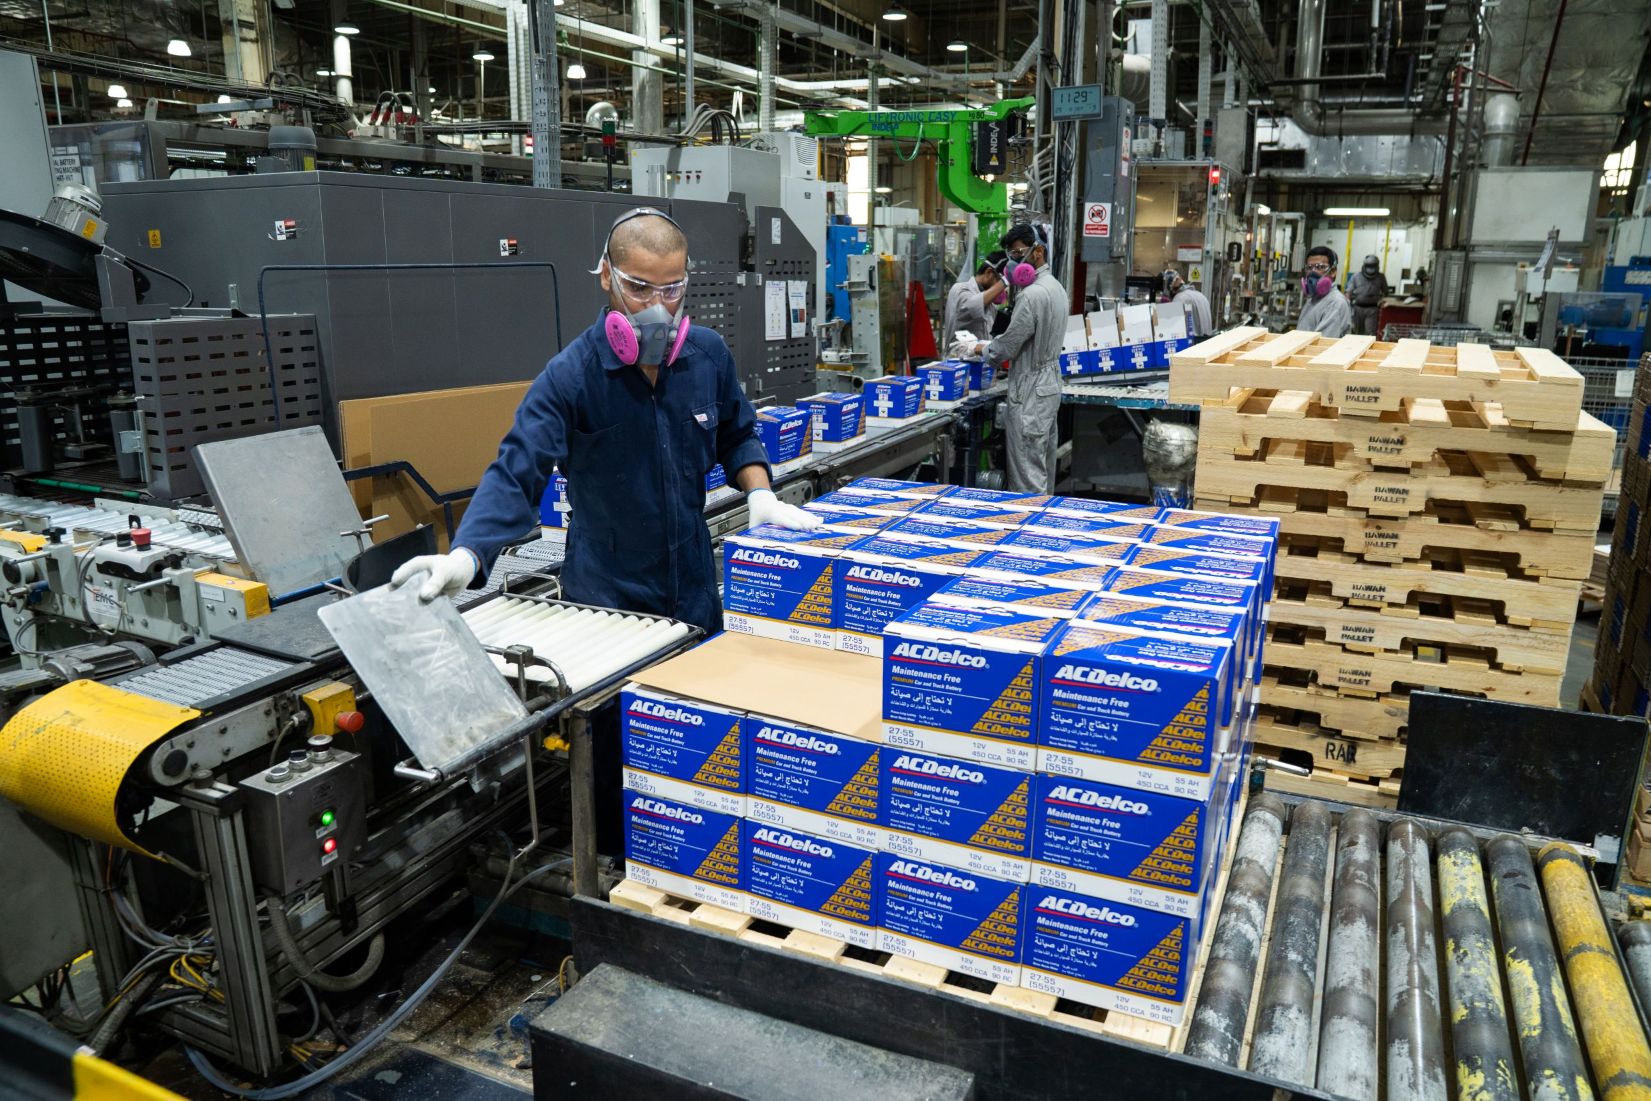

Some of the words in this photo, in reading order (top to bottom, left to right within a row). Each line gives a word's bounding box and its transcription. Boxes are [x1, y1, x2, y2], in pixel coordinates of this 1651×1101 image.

[928, 112, 958, 121] EASY
[989, 122, 1000, 154] INDEVA
[1346, 385, 1380, 394] BAWAN
[842, 402, 858, 412] ACDelco
[1346, 395, 1380, 404] PALLET
[780, 420, 802, 431] ACDelco
[1368, 436, 1404, 446] BAWAN
[1368, 446, 1402, 455] PALLET
[1374, 486, 1409, 495] BAWAN
[1374, 496, 1408, 504] PALLET
[1365, 532, 1398, 540] BAWAN
[1365, 540, 1397, 549] PALLET
[731, 549, 798, 568] ACDelco
[731, 567, 767, 578] Maintenance
[768, 573, 781, 581] Free
[847, 565, 920, 586] ACDelco
[846, 584, 885, 596] Maintenance
[886, 591, 901, 599] Free
[1352, 584, 1386, 592] BAWAN
[1352, 592, 1384, 601] PALLET
[1341, 634, 1374, 642] PALLET
[1342, 625, 1374, 634] BAWAN
[893, 643, 985, 667] ACDelco
[1105, 654, 1210, 672] ACDelco
[892, 666, 942, 679] Maintenance
[943, 673, 961, 683] Free
[1054, 664, 1157, 691] ACDelco
[1338, 676, 1370, 686] PALLET
[1339, 668, 1371, 677] BAWAN
[1052, 689, 1108, 704] Maintenance
[1110, 697, 1129, 708] Free
[629, 700, 702, 725] ACDelco
[628, 719, 668, 734] Maintenance
[669, 728, 684, 738] Free
[972, 721, 1029, 737] ACDelco
[1112, 723, 1118, 731] لا
[756, 727, 837, 753] ACDelco
[755, 747, 799, 762] Maintenance
[801, 757, 817, 767] Free
[1139, 748, 1202, 765] ACDelco
[893, 755, 983, 782] ACDelco
[892, 776, 940, 792] Maintenance
[942, 786, 959, 797] Free
[1136, 779, 1151, 787] 450
[1153, 782, 1168, 790] CCA
[1175, 776, 1184, 784] 55
[1188, 778, 1198, 786] AH
[1048, 785, 1148, 814] ACDelco
[631, 797, 702, 823] ACDelco
[1046, 807, 1100, 824] Maintenance
[1102, 818, 1121, 829] Free
[631, 815, 669, 830] Maintenance
[670, 825, 684, 835] Free
[753, 828, 832, 857] ACDelco
[1104, 842, 1110, 850] لا
[752, 847, 795, 863] Maintenance
[796, 858, 812, 868] Free
[889, 860, 975, 890] ACDelco
[1130, 867, 1191, 885] ACDelco
[887, 880, 934, 897] Maintenance
[935, 892, 952, 902] Free
[1038, 895, 1135, 926] ACDelco
[1036, 916, 1088, 934] Maintenance
[1090, 928, 1108, 939] Free
[1117, 976, 1175, 995] ACDelco
[1114, 1002, 1128, 1011] 450
[1130, 1006, 1144, 1015] CCA
